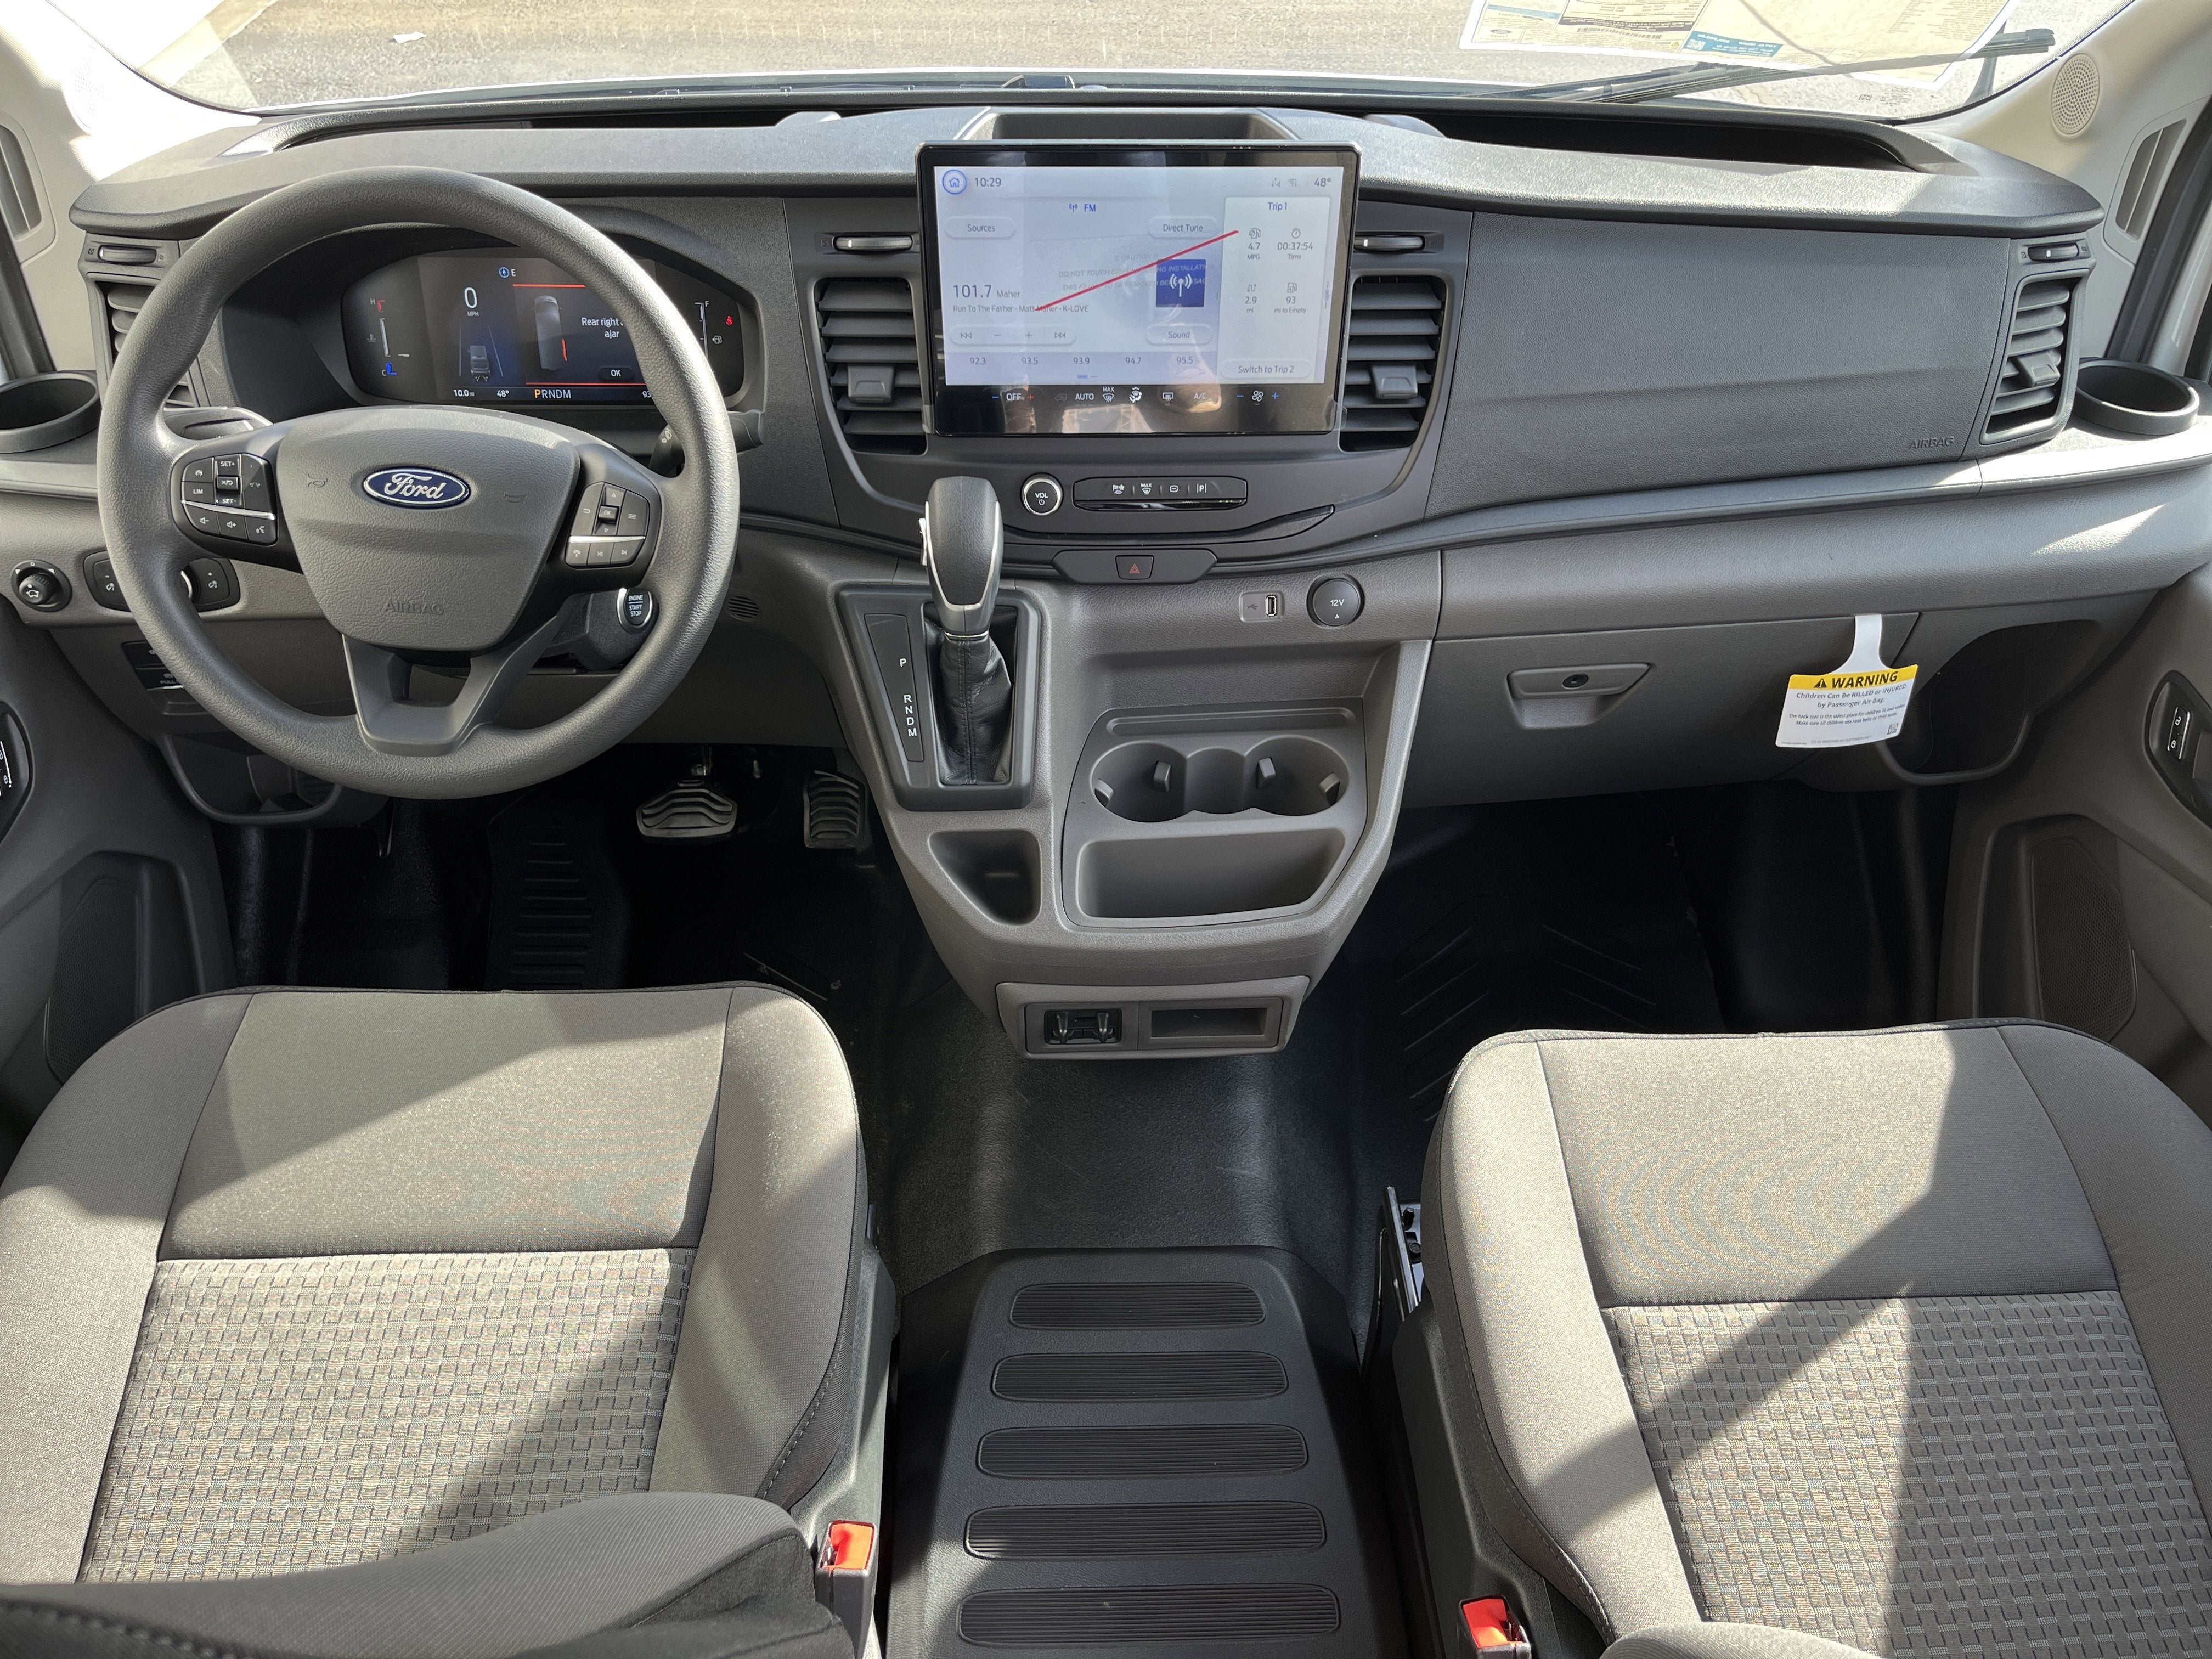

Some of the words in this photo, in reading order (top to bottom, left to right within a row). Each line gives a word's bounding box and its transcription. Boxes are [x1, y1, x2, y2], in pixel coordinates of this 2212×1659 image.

[974, 177, 1001, 187] 10:29
[1314, 178, 1331, 187] 48°
[1084, 204, 1096, 212] FM
[1268, 202, 1283, 211] Trip
[1284, 202, 1288, 210] 1
[967, 224, 995, 233] Sources
[1163, 224, 1183, 232] Direct
[1185, 224, 1203, 232] Tune
[1248, 242, 1260, 251] 4.7
[1277, 242, 1314, 251] 00:37:54
[953, 285, 992, 298] 101.7
[996, 290, 1021, 298] Maher
[464, 287, 477, 308] 0
[1245, 296, 1257, 304] 2.9
[1285, 296, 1296, 304] 93
[582, 317, 599, 326] Rear
[601, 317, 620, 327] right
[605, 330, 619, 339] ajar
[1168, 330, 1190, 339] Sound
[1176, 357, 1193, 365] 95.5
[1238, 365, 1262, 374] Switch
[1274, 365, 1288, 375] Trip
[453, 389, 469, 397] 10.0
[1006, 392, 1022, 401] OFF
[1075, 393, 1094, 401] AUTO
[1194, 392, 1206, 400] A/C
[1908, 436, 1954, 450] AIRBAG
[384, 473, 447, 500] Ford
[1330, 599, 1345, 607] 12V
[385, 601, 445, 616] AIRBAG
[899, 658, 907, 667] P
[1832, 671, 1898, 689] WARNING
[1882, 684, 1907, 693] INJURED
[904, 694, 912, 703] R
[905, 706, 913, 715] N
[906, 716, 915, 726] D
[907, 727, 917, 737] M
